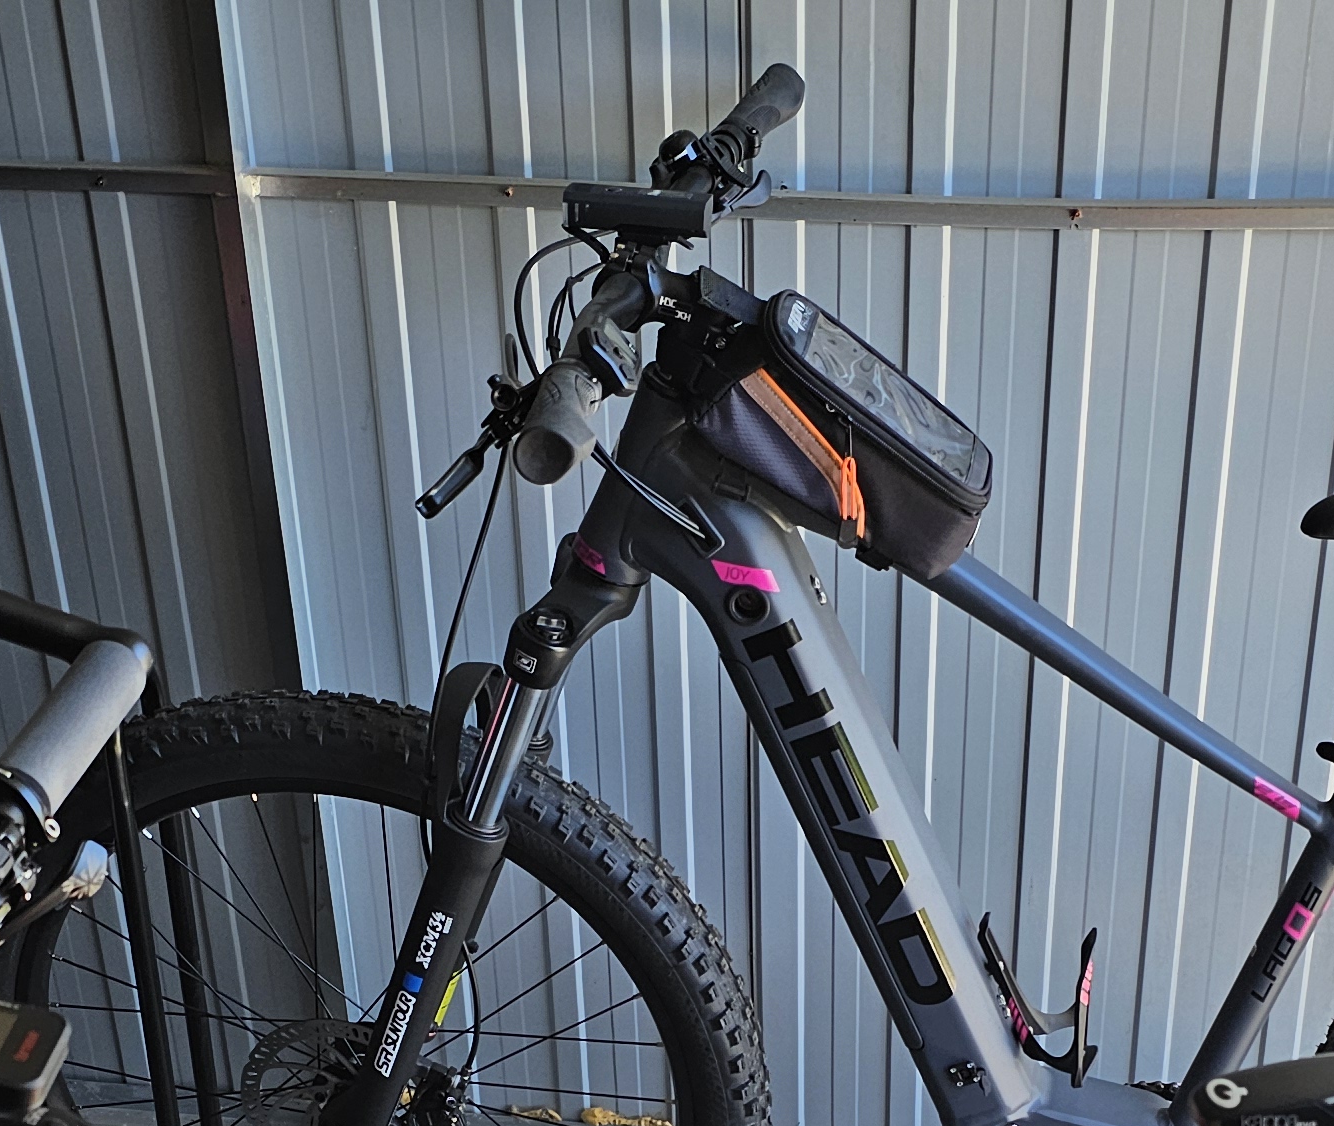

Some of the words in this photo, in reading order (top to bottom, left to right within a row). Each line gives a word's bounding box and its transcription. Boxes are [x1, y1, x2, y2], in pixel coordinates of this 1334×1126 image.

[724, 567, 751, 582] JOY
[741, 617, 957, 1006] HEAD
[1251, 881, 1323, 1003] LAGOS
[383, 992, 416, 1049] SUNTOUR
